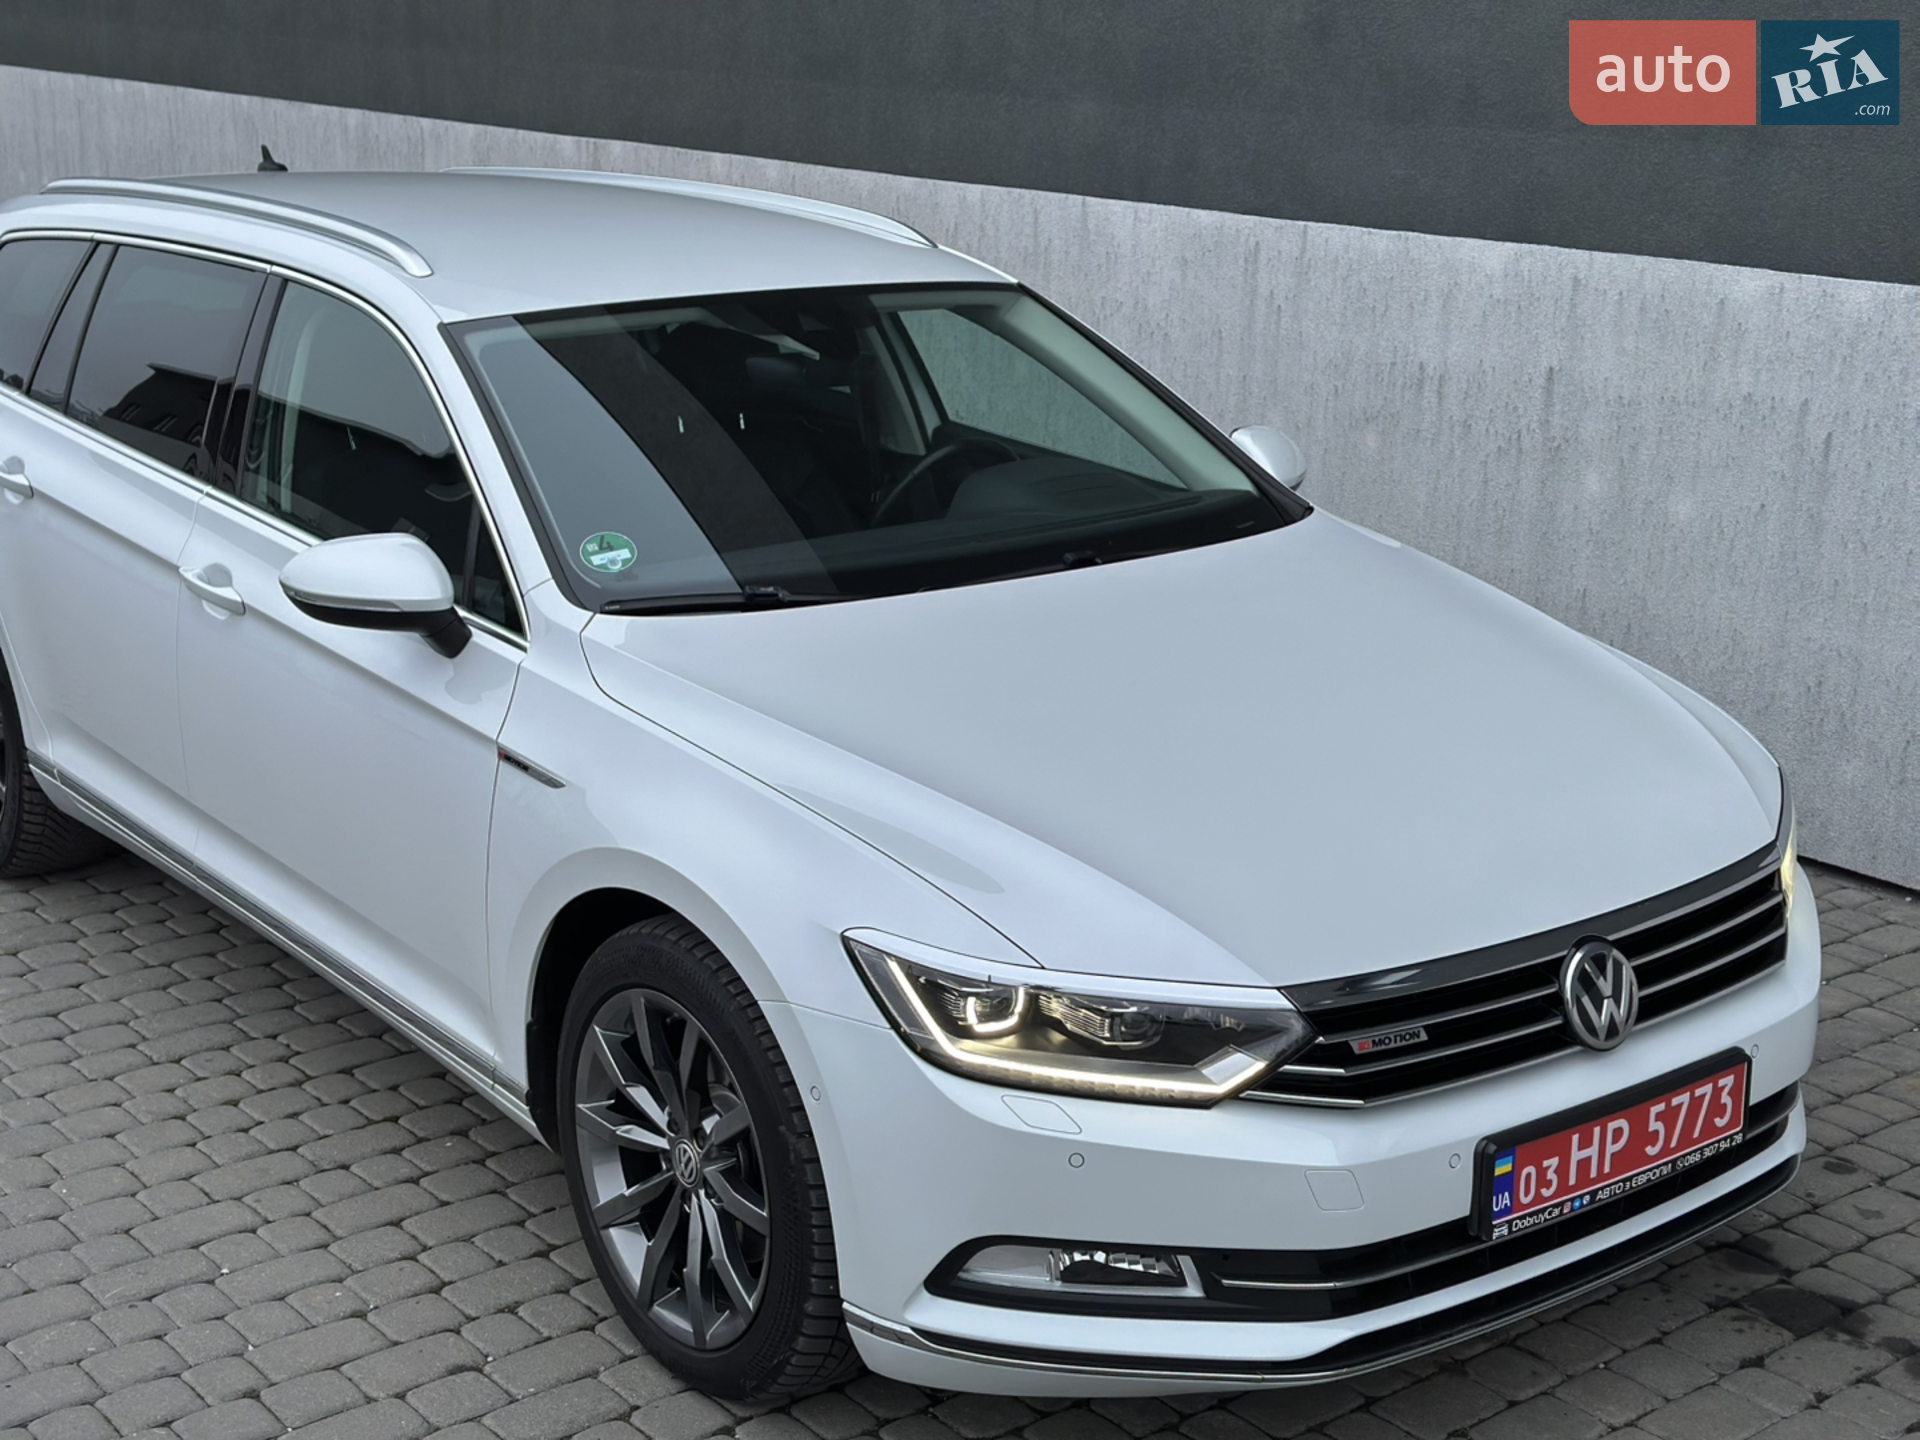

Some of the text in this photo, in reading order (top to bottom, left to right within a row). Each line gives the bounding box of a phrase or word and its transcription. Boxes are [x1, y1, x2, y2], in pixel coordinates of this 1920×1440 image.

[1519, 1156, 1560, 1204] 03
[1644, 1074, 1735, 1156] 5773
[1493, 1191, 1511, 1211] UA
[1512, 1206, 1562, 1232] DobruyCar
